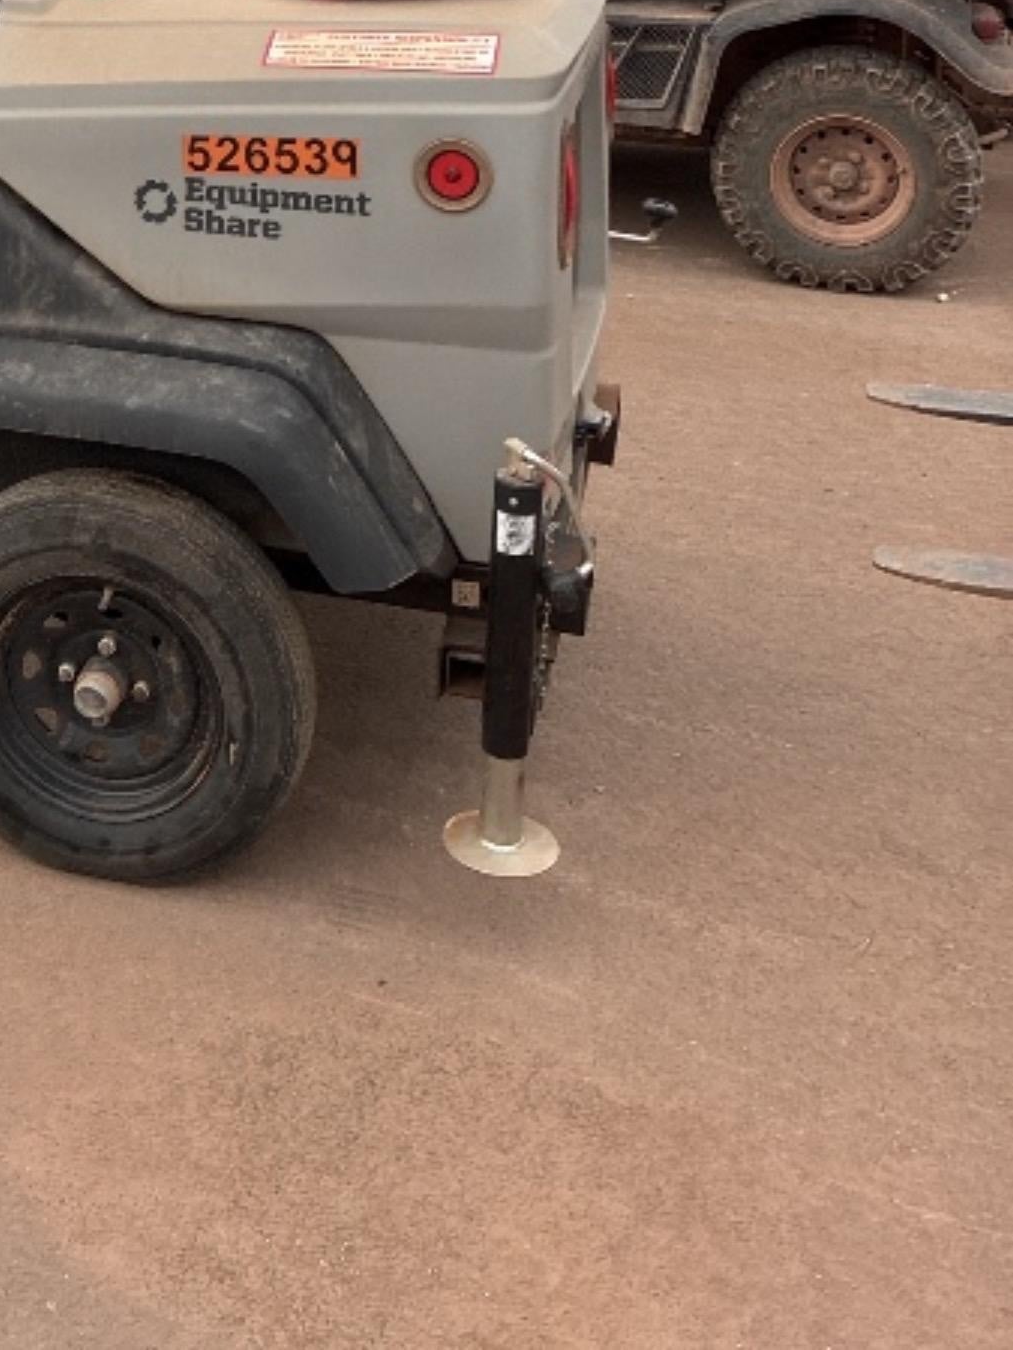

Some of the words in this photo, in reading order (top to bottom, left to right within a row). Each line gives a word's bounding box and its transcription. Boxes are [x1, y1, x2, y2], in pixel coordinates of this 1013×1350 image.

[187, 134, 358, 177] 526539
[184, 177, 372, 217] Equipment
[185, 207, 282, 240] Share
